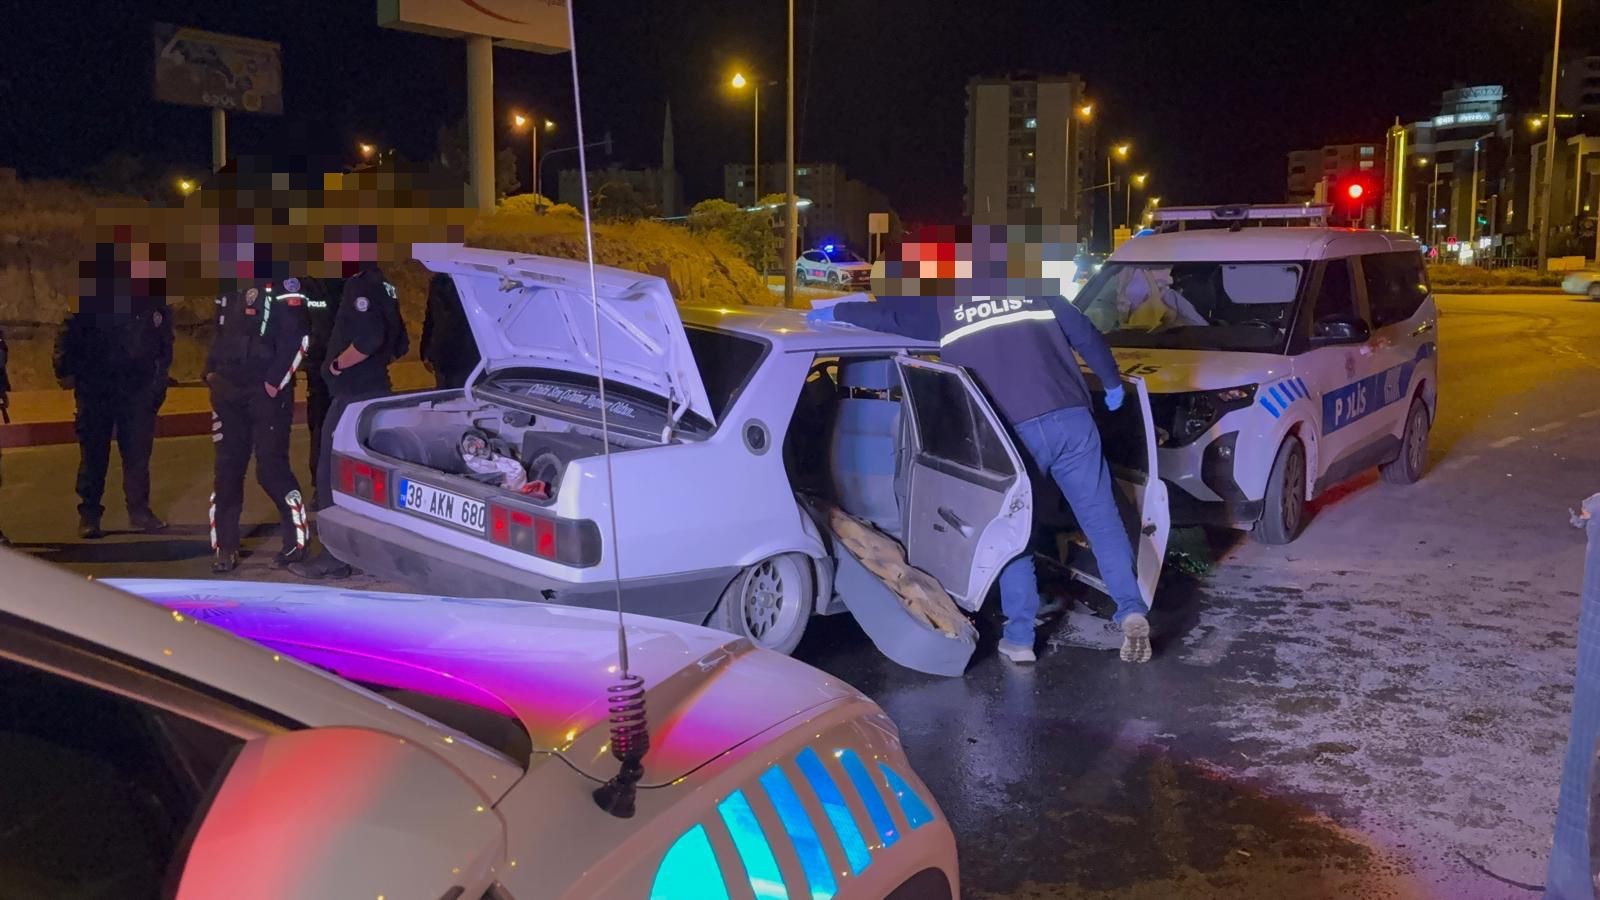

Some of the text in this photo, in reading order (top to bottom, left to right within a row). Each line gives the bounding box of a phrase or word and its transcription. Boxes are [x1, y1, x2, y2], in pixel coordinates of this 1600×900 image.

[407, 484, 486, 529] 38 AKN 680
